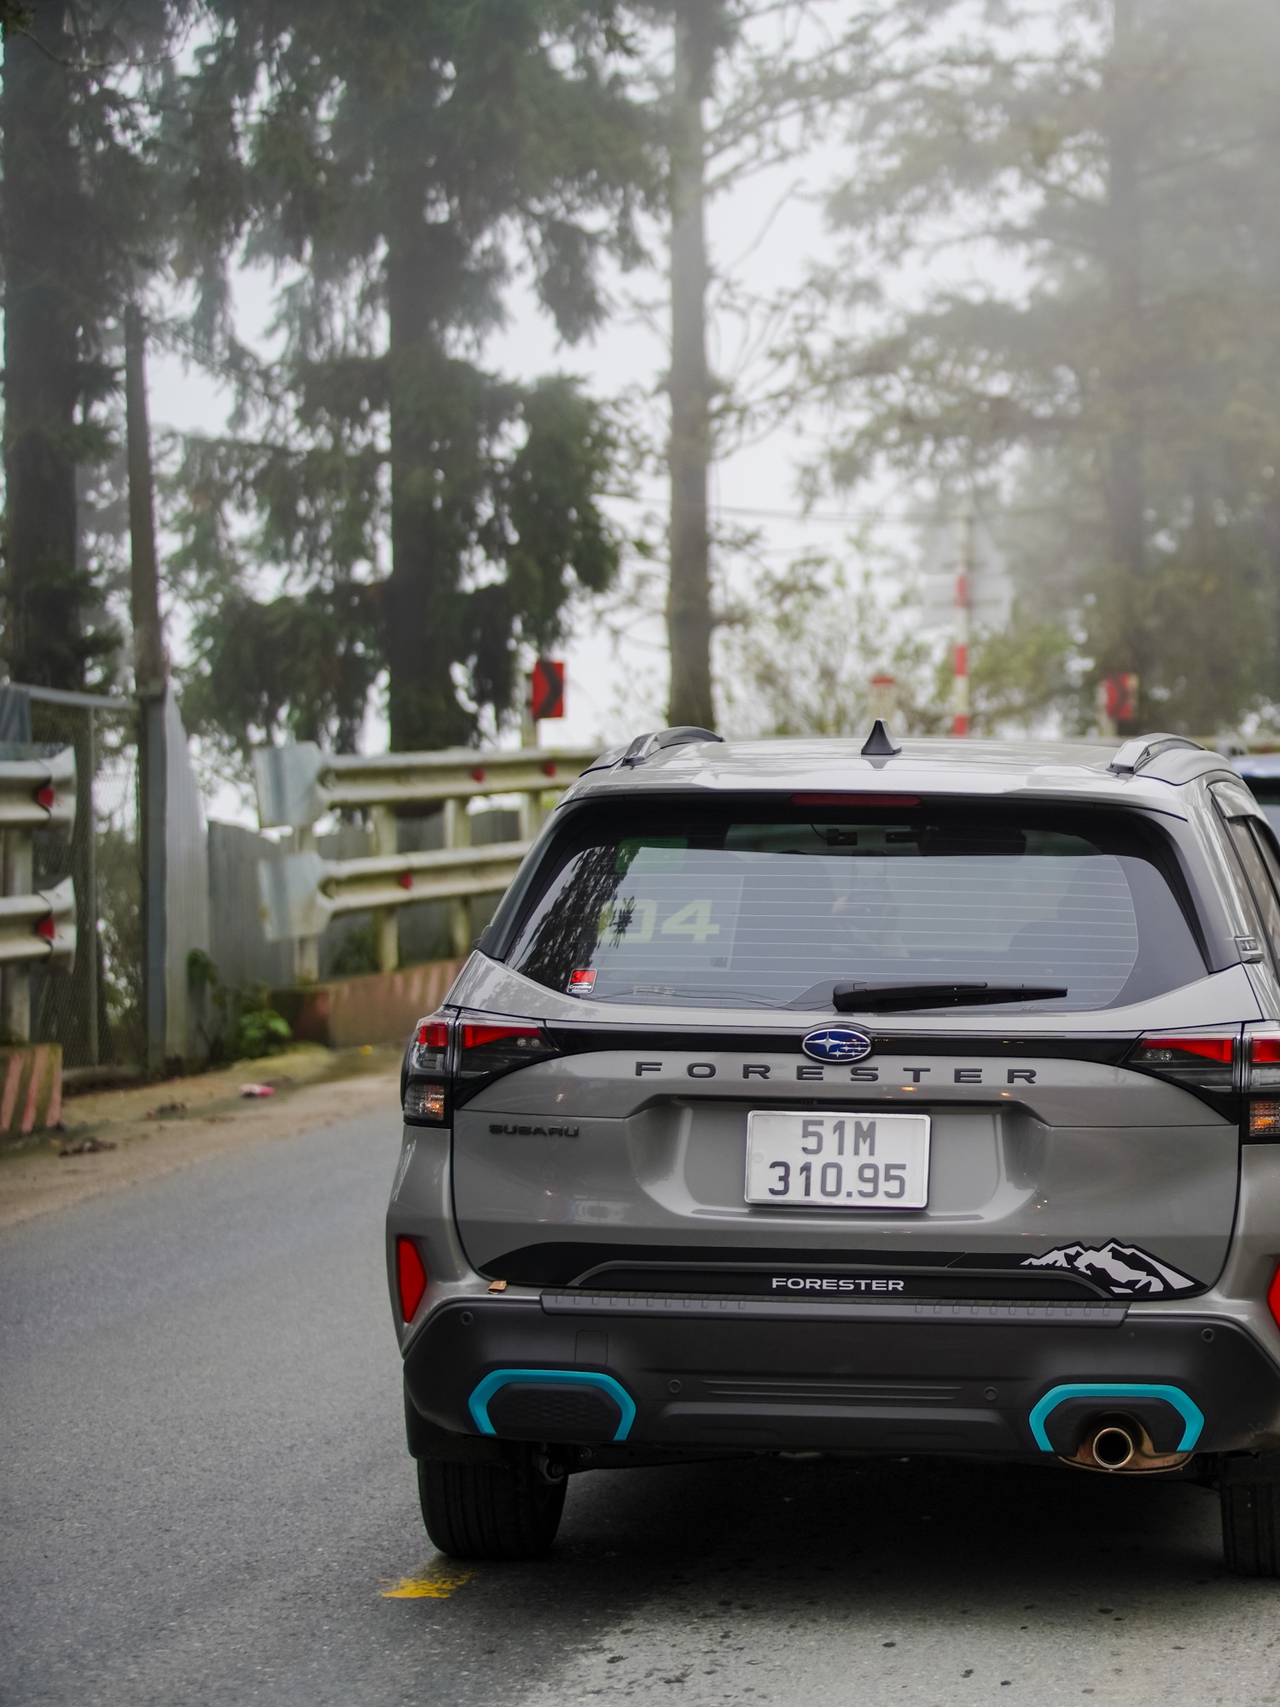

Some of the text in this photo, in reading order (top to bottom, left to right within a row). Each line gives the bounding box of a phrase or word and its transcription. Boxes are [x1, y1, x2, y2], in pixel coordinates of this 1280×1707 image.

[571, 970, 595, 983] 3M
[635, 1061, 1037, 1084] FORESTER
[489, 1124, 579, 1137] SUBARU
[801, 1119, 876, 1156] 51M
[768, 1160, 906, 1199] 310.95
[772, 1277, 905, 1291] FORESTER
